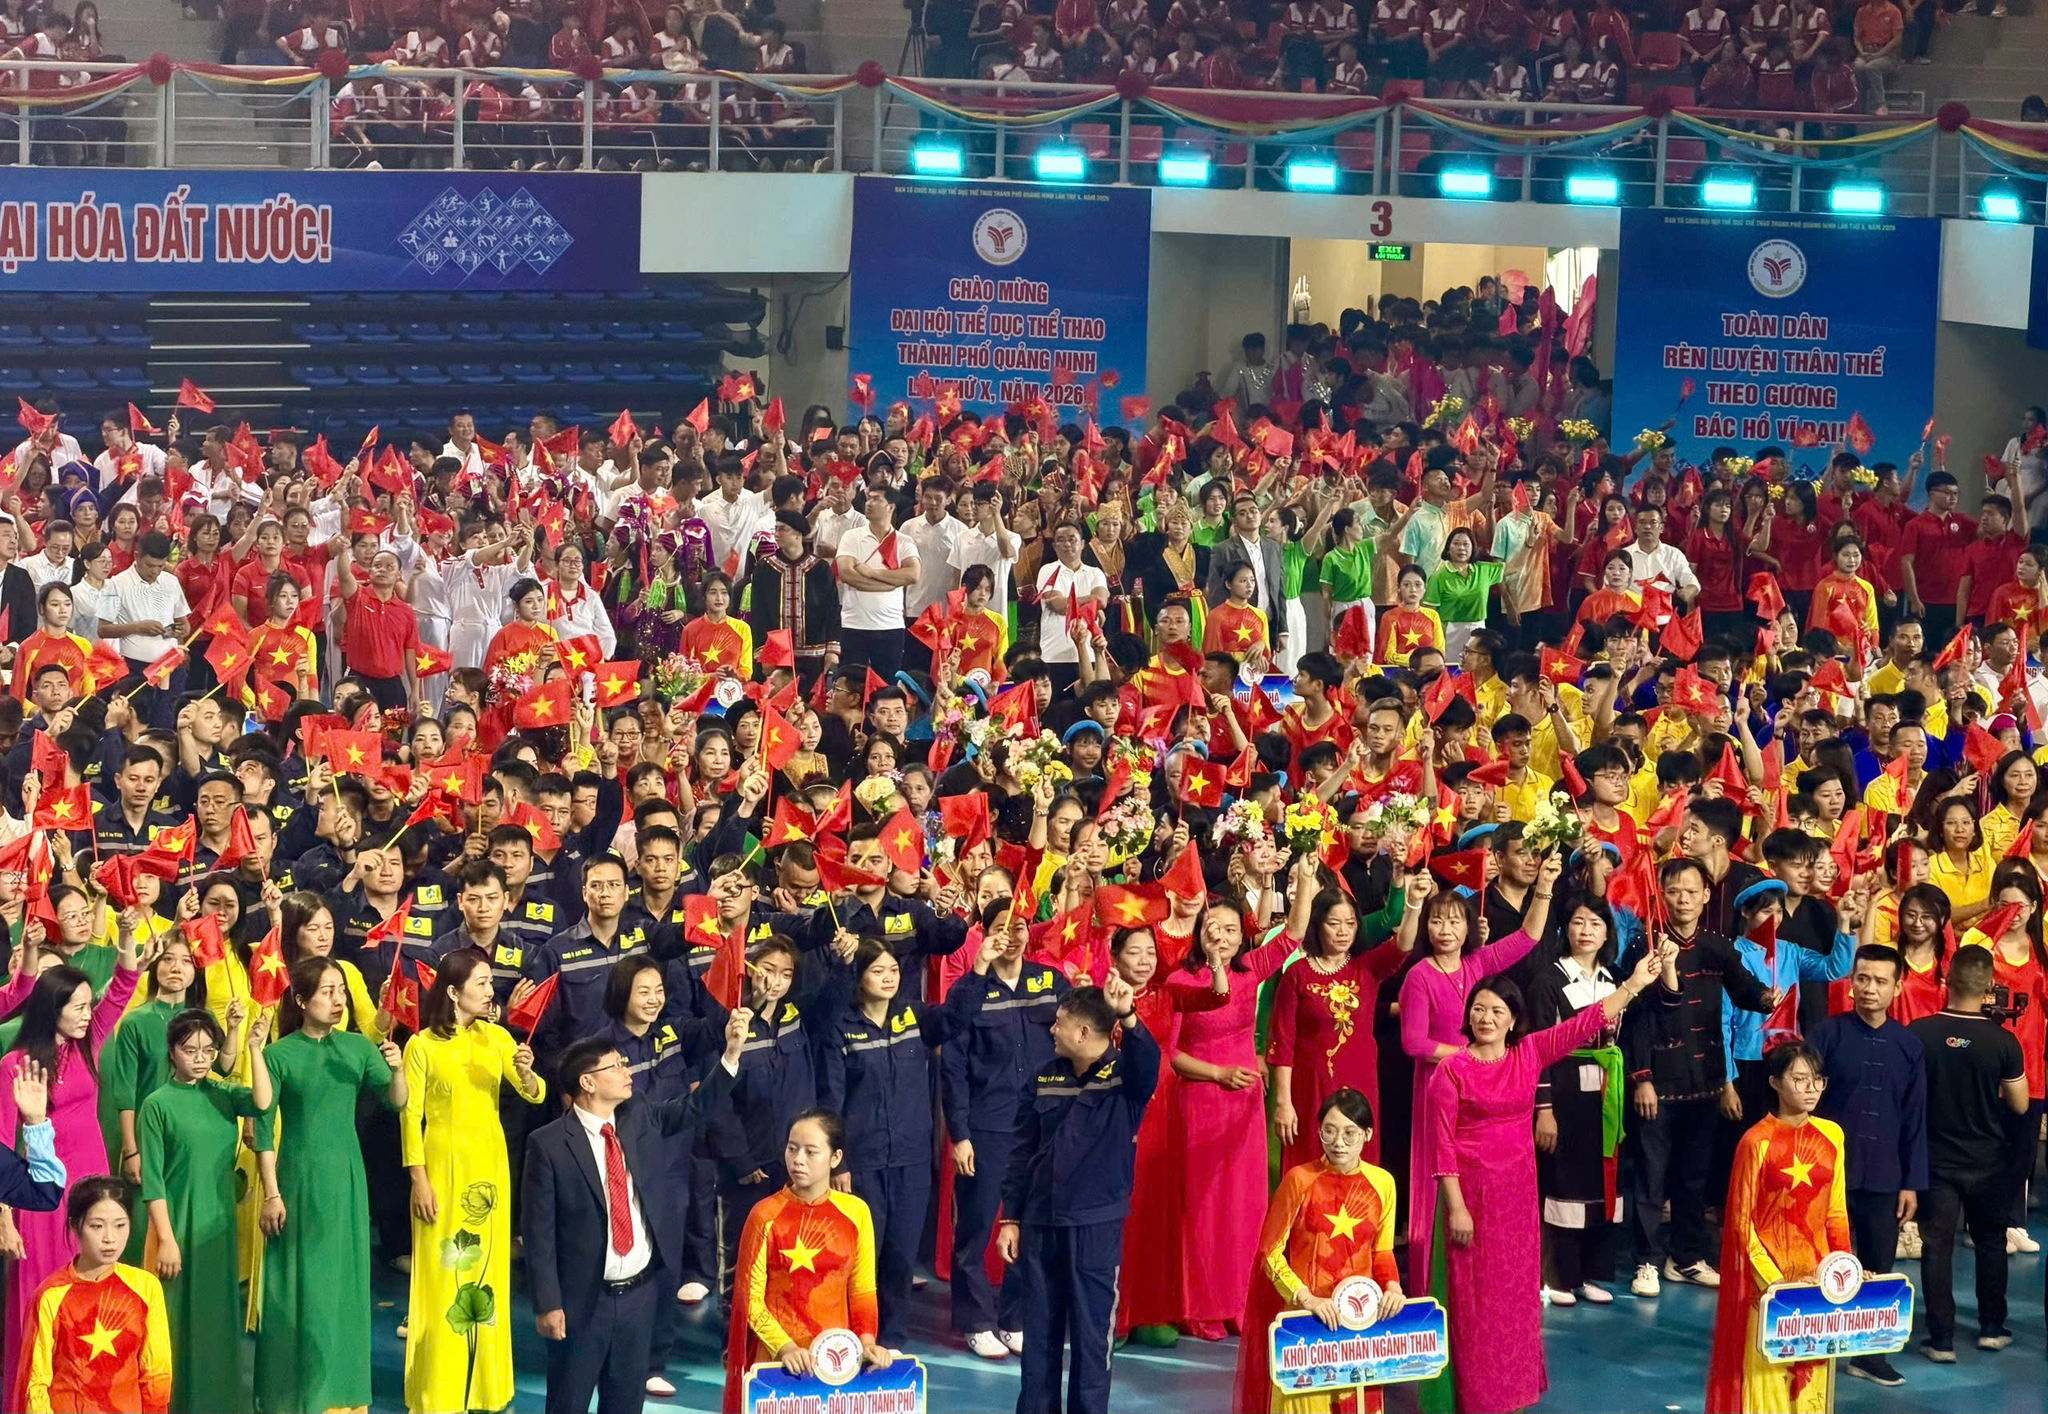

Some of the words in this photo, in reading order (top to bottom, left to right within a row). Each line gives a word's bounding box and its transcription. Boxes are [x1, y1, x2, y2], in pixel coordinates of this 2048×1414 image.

[47, 192, 126, 262] HÓA
[133, 185, 206, 262] ĐẤT
[216, 194, 332, 263] NƯỚC!
[1370, 201, 1392, 236] 3
[1378, 246, 1403, 254] EXIT
[950, 277, 993, 301] CHÀO
[999, 278, 1048, 303] MỪNG
[891, 310, 920, 335] ĐẠI
[923, 308, 950, 337] HỘI
[957, 306, 988, 334] THỂ
[990, 315, 1022, 341] DỤC
[1028, 309, 1060, 338] THỂ
[1062, 318, 1105, 340] THAO
[1722, 311, 1777, 338] TOÀN
[1782, 313, 1827, 340] DÂN
[898, 341, 950, 366] THÀNH
[956, 340, 992, 367] PHỐ
[994, 343, 1050, 370] QUẢNG
[1055, 351, 1097, 373] NINH
[1664, 343, 1706, 369] RÈN
[1712, 346, 1777, 376] LUYỆN
[1784, 349, 1839, 374] THÂN
[1845, 346, 1886, 376] THỂ
[979, 380, 996, 403] X,
[1000, 379, 1039, 402] NĂM
[1044, 385, 1085, 404] 2026
[1707, 382, 1758, 405] THEO
[1764, 386, 1837, 409] GƯƠNG
[1695, 413, 1736, 438] BÁC
[1742, 411, 1771, 440] HỒ
[1776, 416, 1798, 441] VĨ
[1777, 1309, 1801, 1337] KHỐI
[1803, 1314, 1825, 1339] PHỤ
[1826, 1308, 1843, 1332] NỮ
[1843, 1306, 1877, 1331] THÀNH
[1878, 1300, 1899, 1328] PHỐ
[1283, 1338, 1307, 1368] KHỐI
[1310, 1339, 1338, 1365] CÔNG
[1341, 1335, 1370, 1362] NHÂN
[1372, 1331, 1408, 1358] NGÀNH
[1410, 1332, 1437, 1354] THAN
[757, 1391, 778, 1414] KHỐI
[867, 1386, 895, 1414] THÀNH
[897, 1381, 916, 1412] PHỐ
